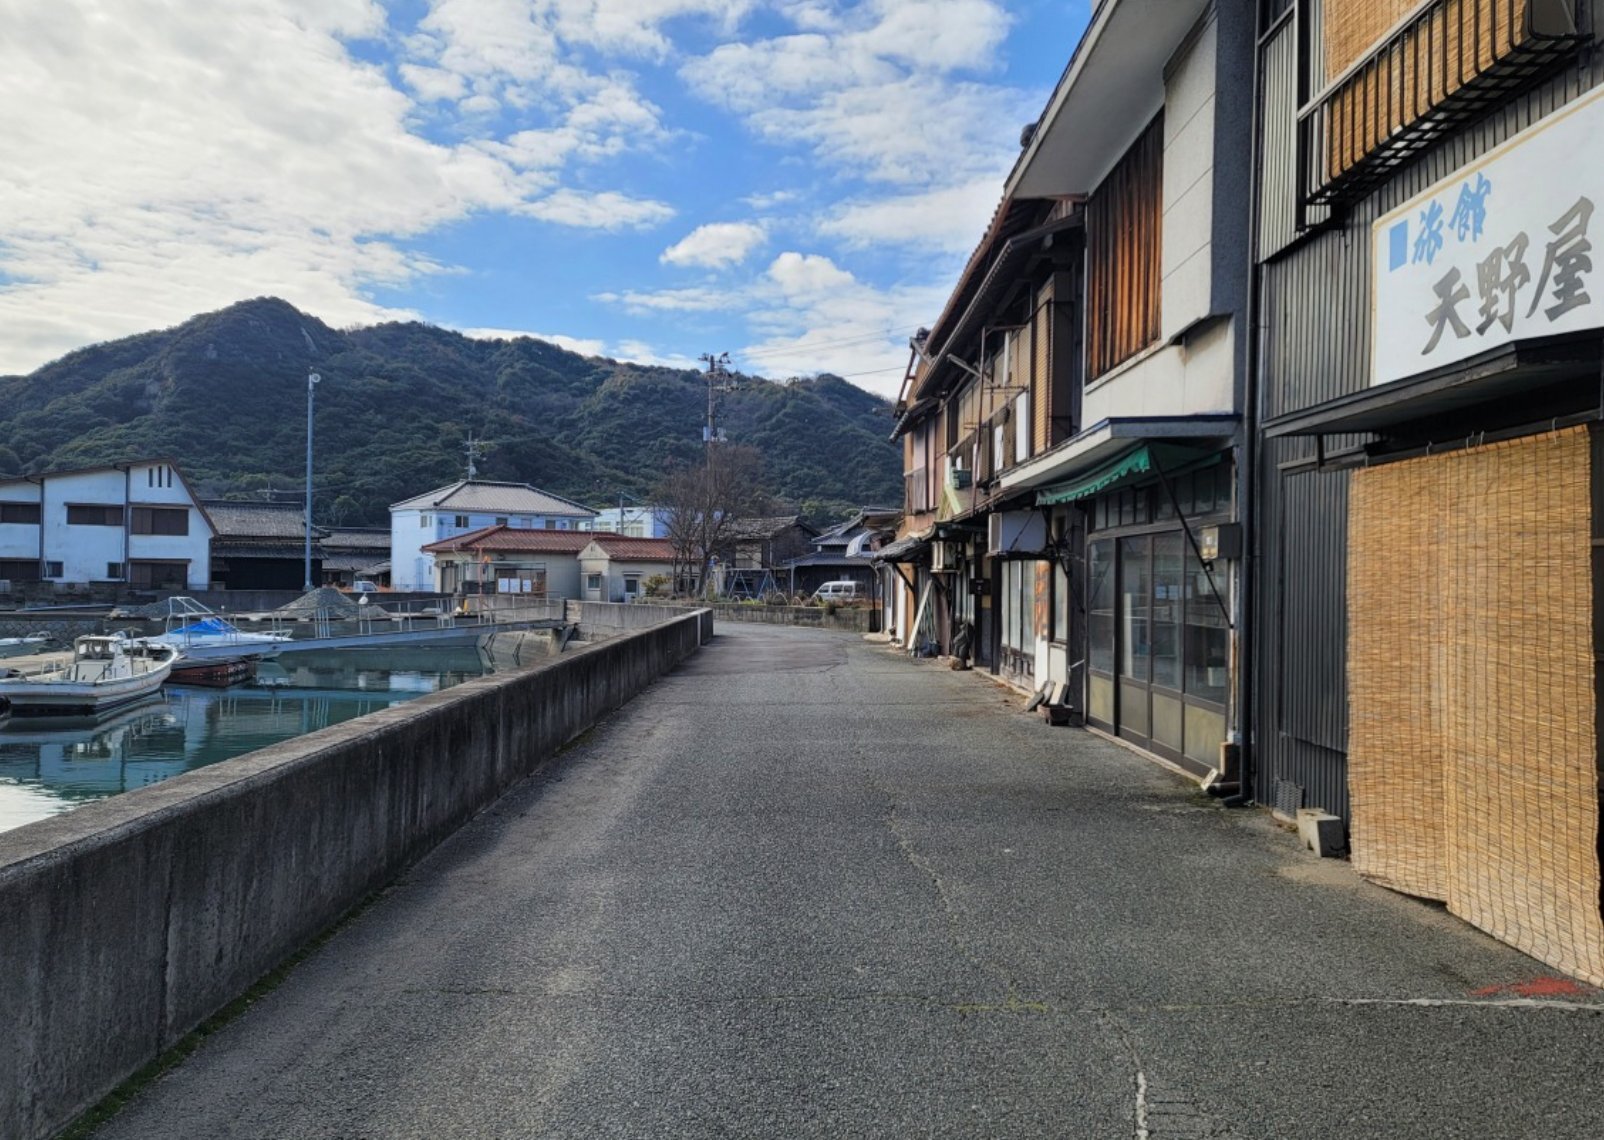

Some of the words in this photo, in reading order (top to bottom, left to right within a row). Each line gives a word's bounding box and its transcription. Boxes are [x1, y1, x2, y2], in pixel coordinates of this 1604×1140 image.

[1412, 172, 1491, 266] 旅館
[1421, 195, 1595, 356] 天野屋
